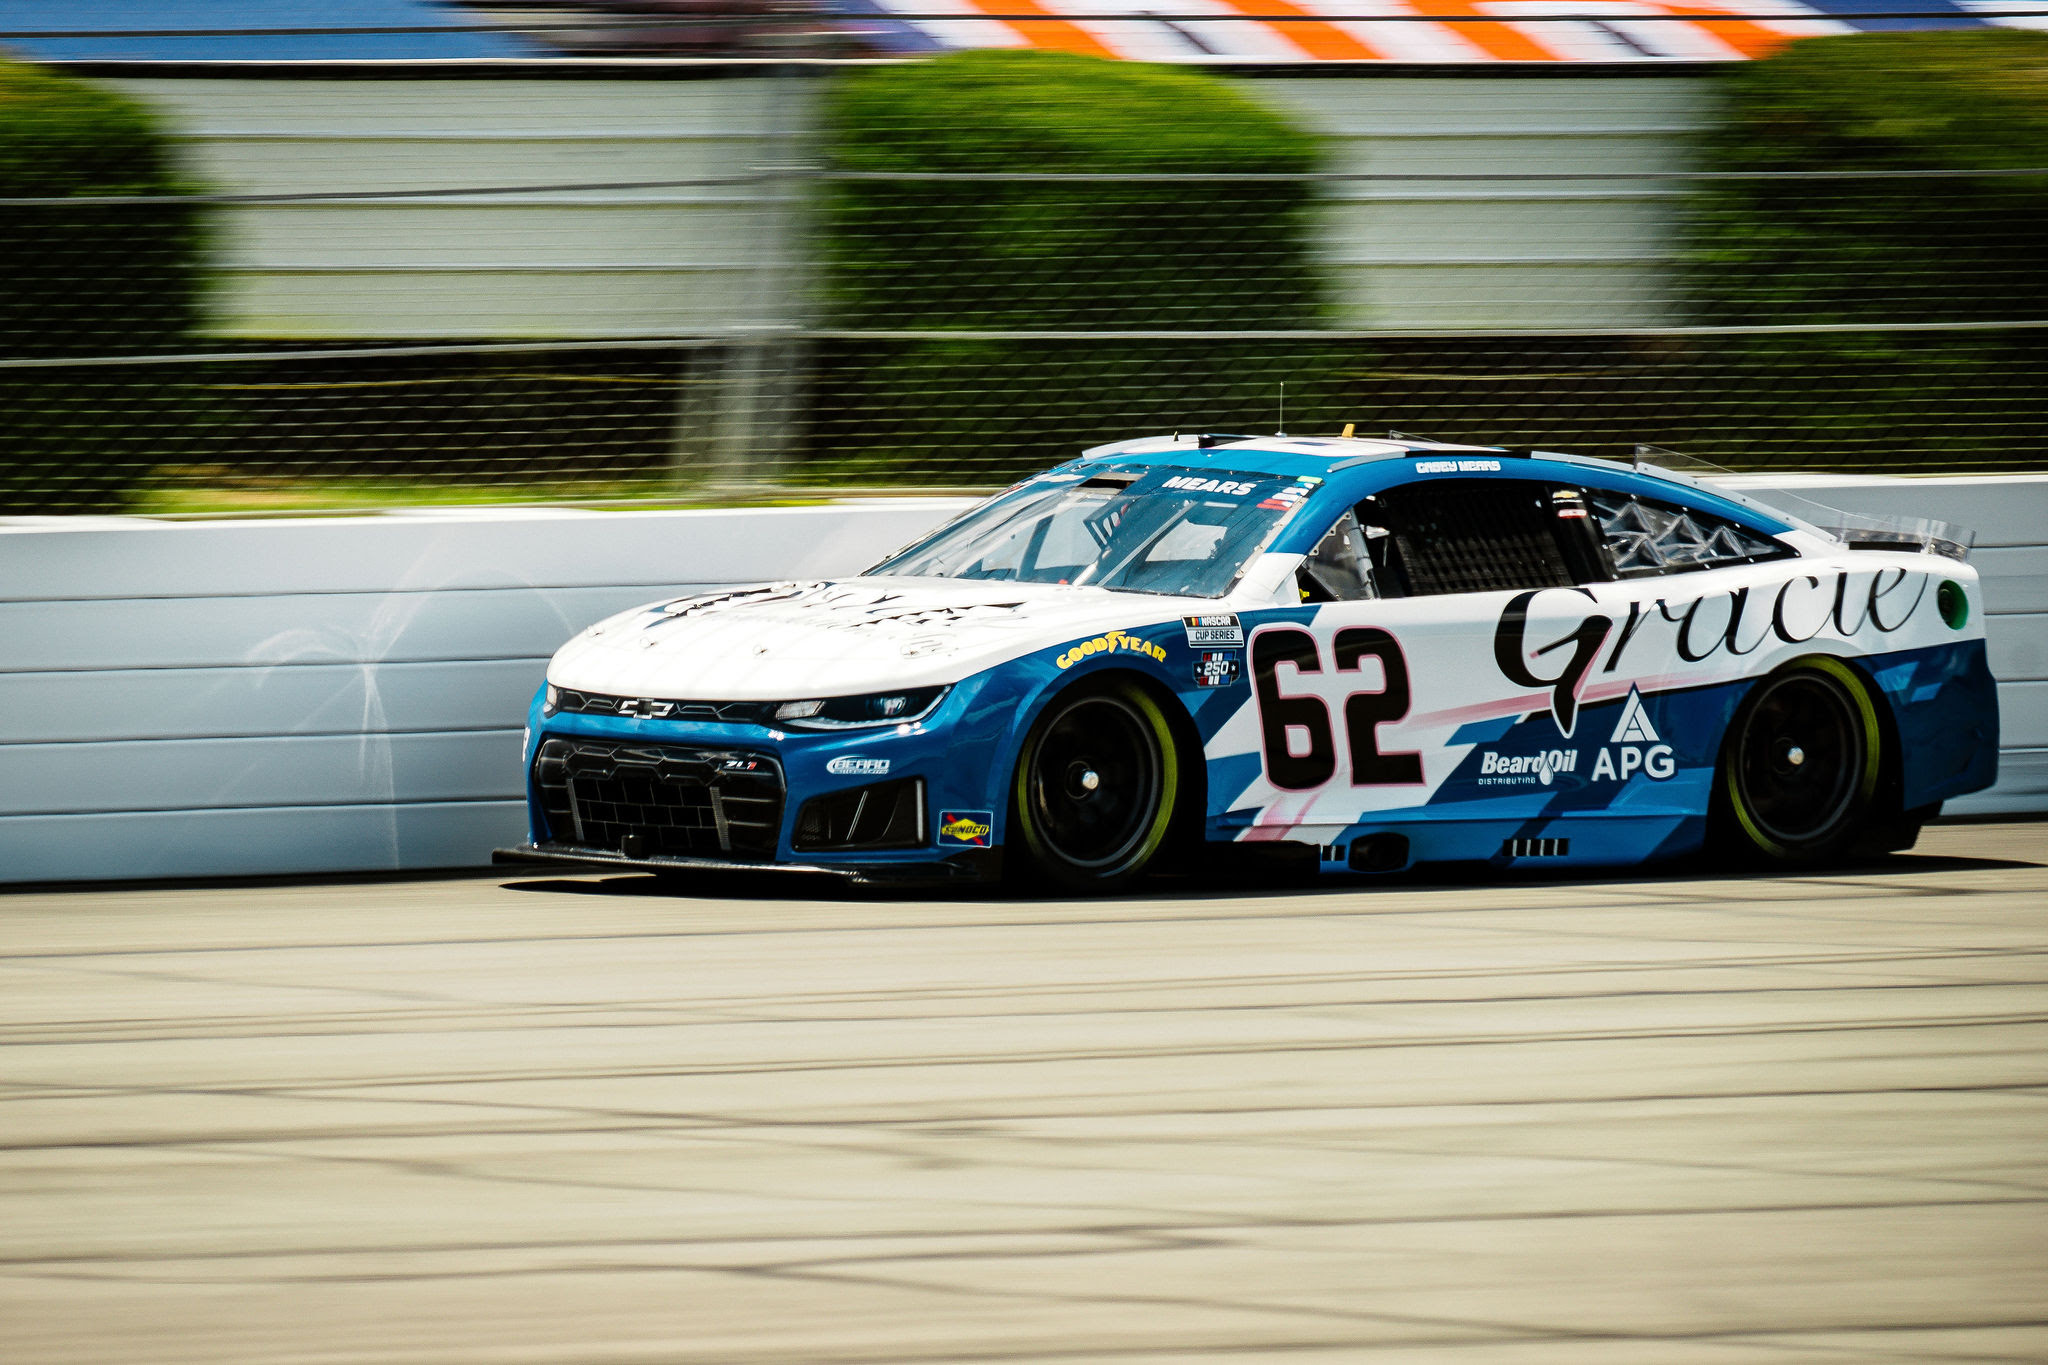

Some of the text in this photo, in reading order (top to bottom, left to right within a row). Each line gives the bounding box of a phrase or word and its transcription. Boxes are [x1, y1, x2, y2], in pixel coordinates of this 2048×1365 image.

[1458, 461, 1501, 471] MEARS
[1162, 475, 1257, 495] MEARS
[1201, 616, 1231, 626] NASCAR
[1195, 630, 1235, 640] CUP SERIES
[1056, 631, 1167, 670] GOODYEAR
[1494, 566, 1929, 739] Gracie
[1203, 661, 1229, 676] 250
[1250, 625, 1427, 793] 62
[834, 759, 890, 770] BEARD
[1591, 744, 1675, 782] APG
[944, 825, 988, 835] SUNOCO
